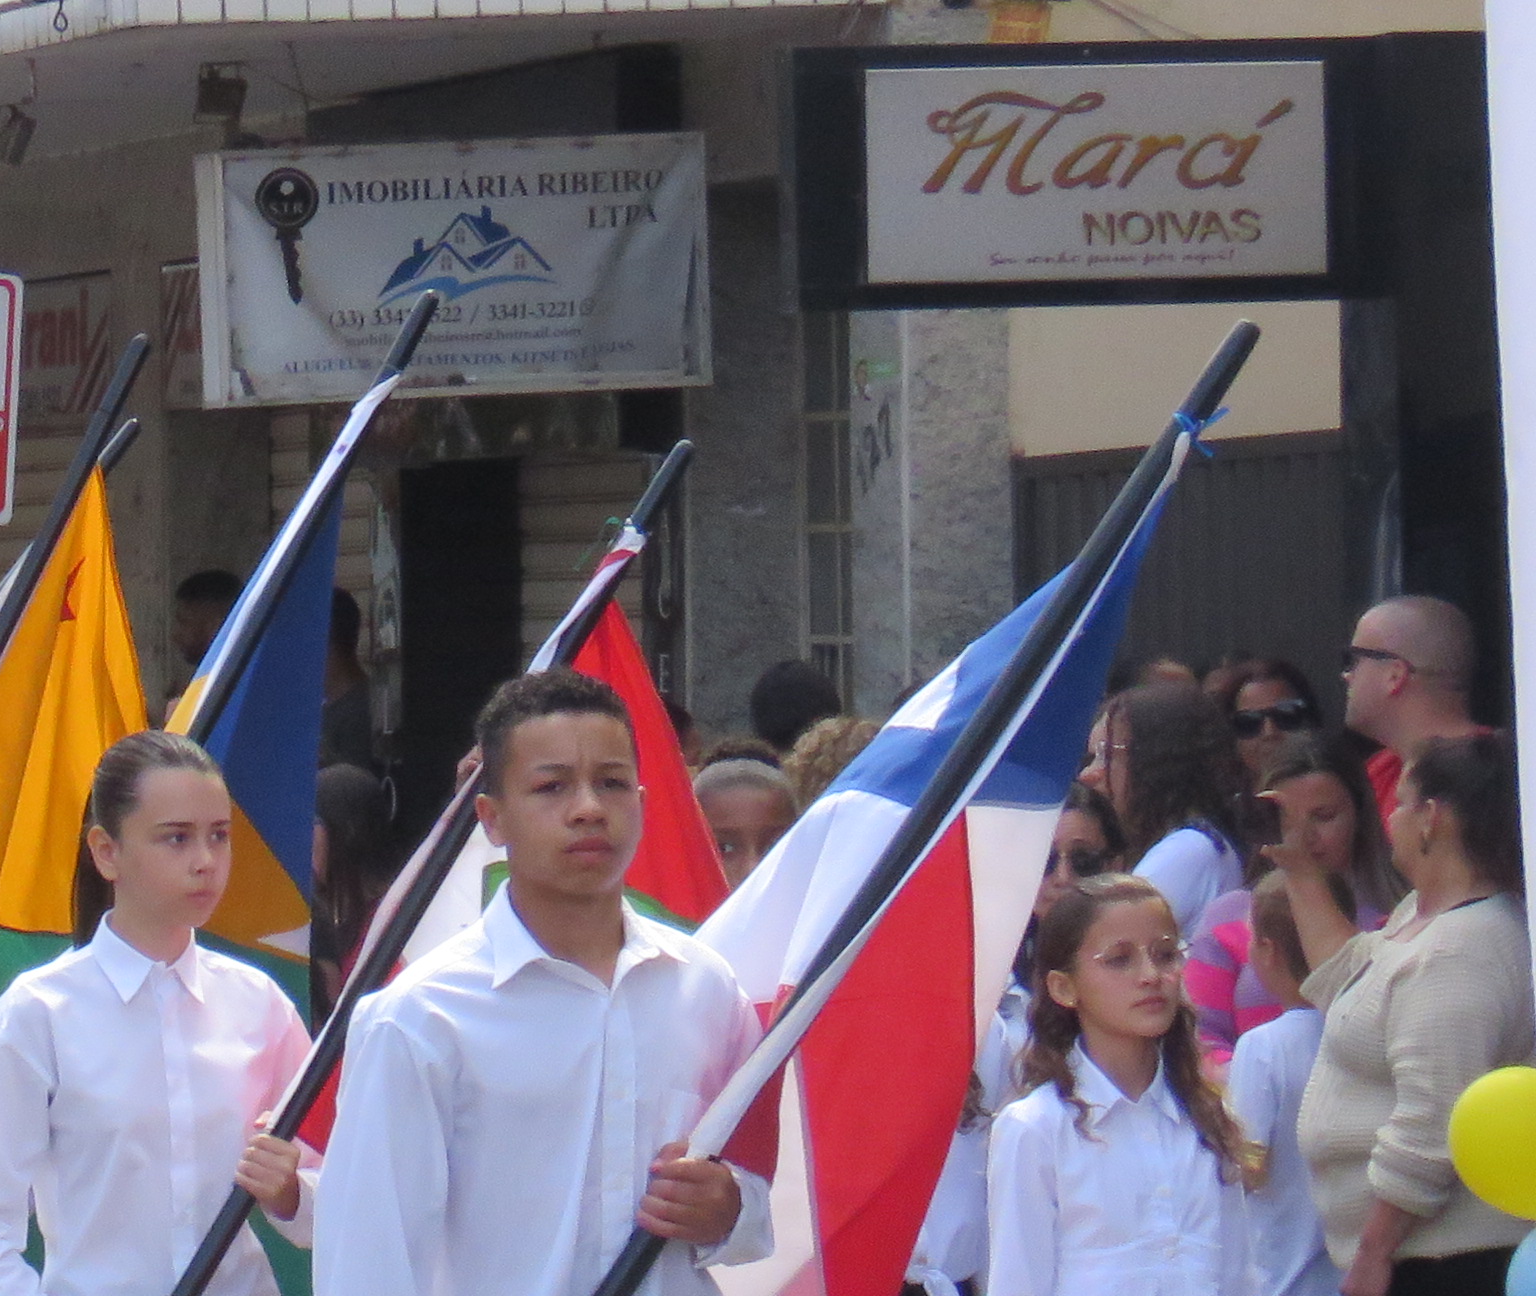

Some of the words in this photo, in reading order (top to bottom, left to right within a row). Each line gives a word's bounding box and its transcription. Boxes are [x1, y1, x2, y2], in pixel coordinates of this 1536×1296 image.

[328, 169, 528, 205] IMOBILIÁRIA
[537, 168, 664, 196] RIBEIRO
[1082, 208, 1262, 247] NOIVAS
[329, 304, 365, 330] (33)
[488, 299, 575, 323] 3341-3221
